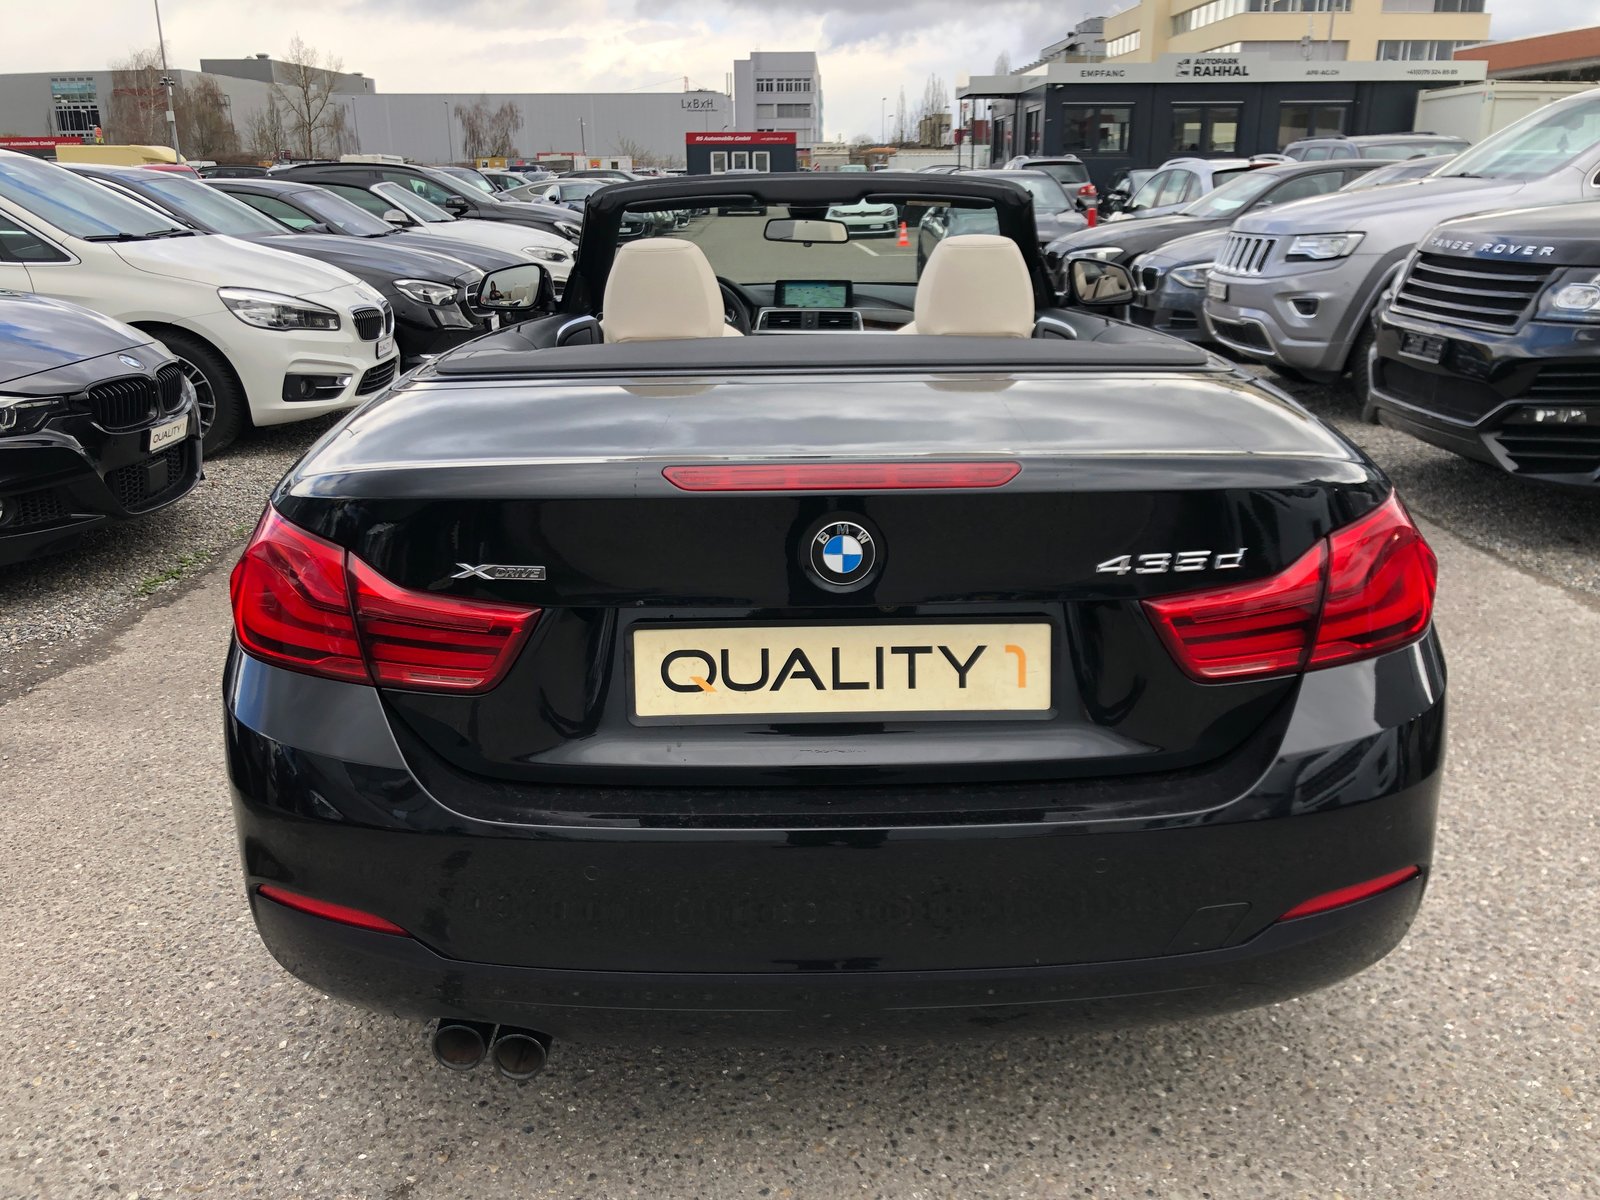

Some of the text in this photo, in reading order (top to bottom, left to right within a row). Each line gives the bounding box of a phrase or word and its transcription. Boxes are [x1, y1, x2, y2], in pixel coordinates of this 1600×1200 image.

[1080, 70, 1126, 78] EMPFANG
[1193, 66, 1249, 77] RAHHAL
[1431, 237, 1555, 257] RANGE ROVER
[817, 524, 870, 545] BMW
[1096, 547, 1249, 576] 435d
[660, 644, 1027, 693] QUALITY 1
